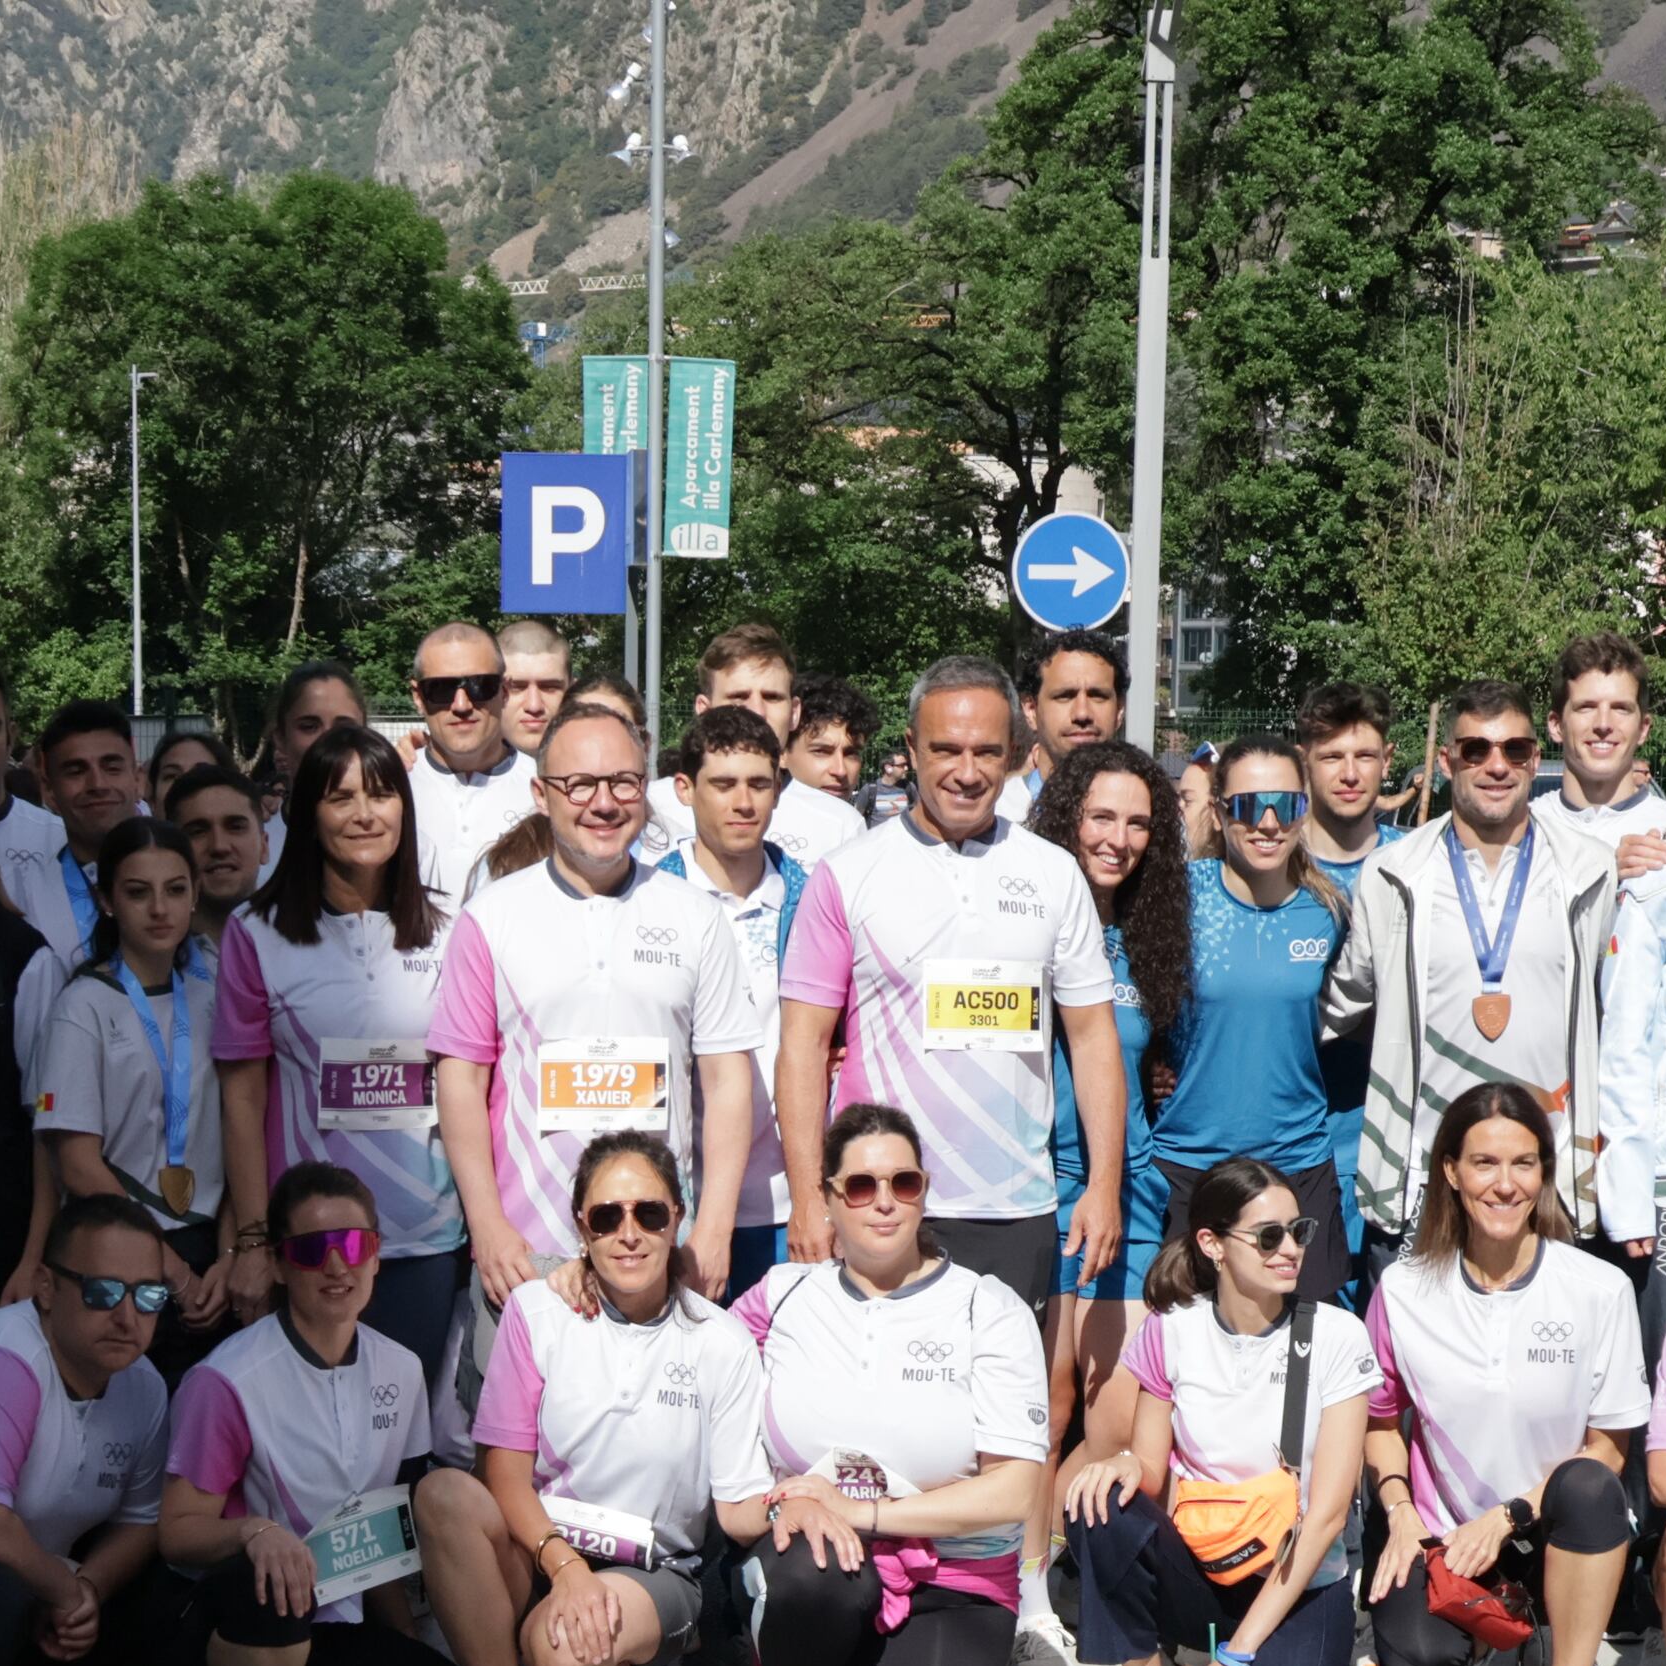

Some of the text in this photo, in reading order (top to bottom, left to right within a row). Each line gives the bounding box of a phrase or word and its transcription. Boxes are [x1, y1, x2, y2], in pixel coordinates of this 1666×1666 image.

[679, 385, 702, 509] Aparcament
[703, 367, 730, 510] illa Carlemany
[531, 485, 606, 586] P
[998, 899, 1046, 920] MOU-TE
[634, 949, 682, 968] MOU-TE
[953, 990, 1020, 1011] AC500
[969, 1014, 1000, 1027] 3301
[351, 1064, 407, 1088] 1971
[571, 1063, 637, 1088] 1979
[353, 1089, 408, 1106] MONICA
[575, 1089, 632, 1105] XAVIER
[1527, 1348, 1576, 1365] MOU-TE
[902, 1368, 956, 1383] MOU-TE
[330, 1519, 377, 1552] 571
[332, 1544, 384, 1574] NOELIA
